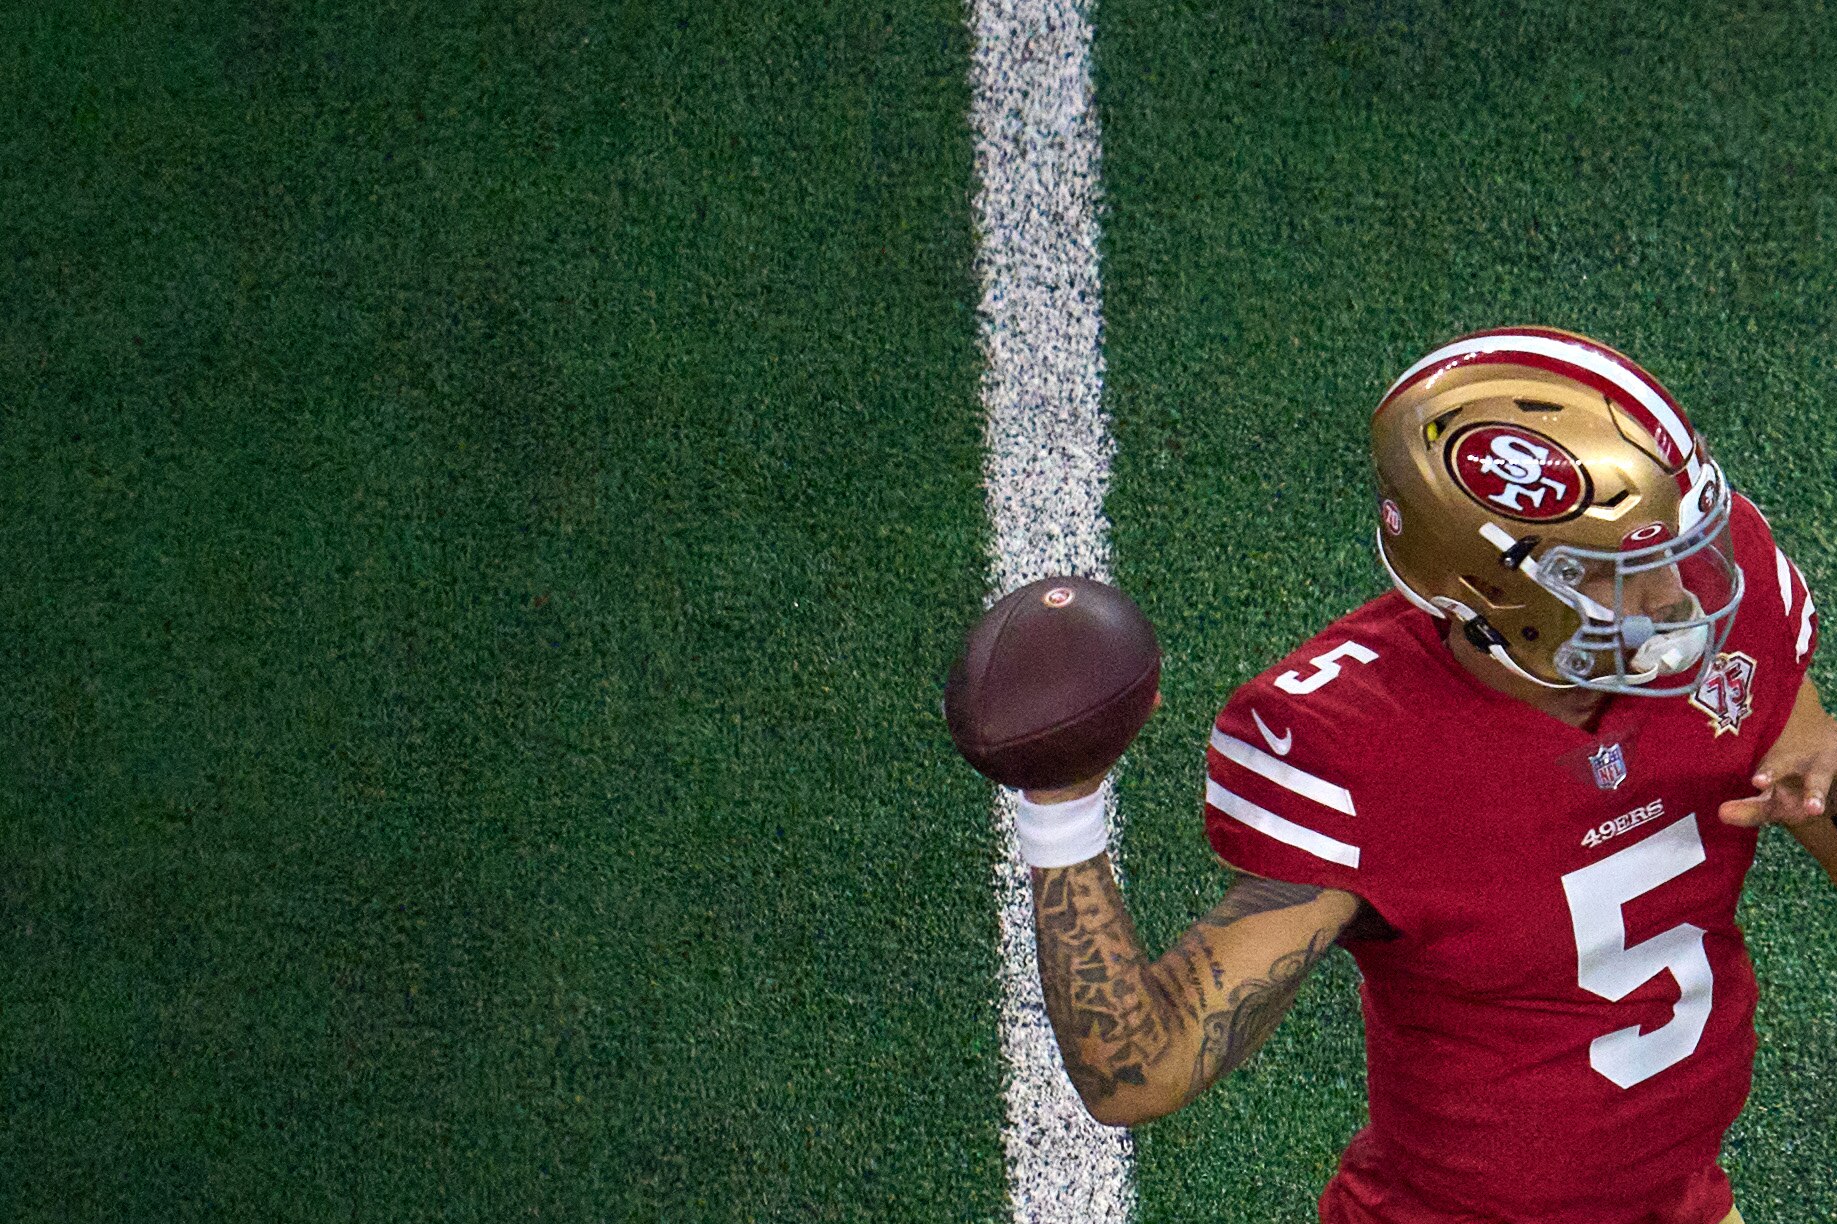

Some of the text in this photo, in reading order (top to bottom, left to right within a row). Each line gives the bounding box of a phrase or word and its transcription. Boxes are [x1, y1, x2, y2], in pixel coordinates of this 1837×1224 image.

[1273, 640, 1380, 695] 5
[1703, 662, 1748, 716] 75
[1580, 798, 1665, 849] 49ERS
[1560, 812, 1714, 1090] 5
